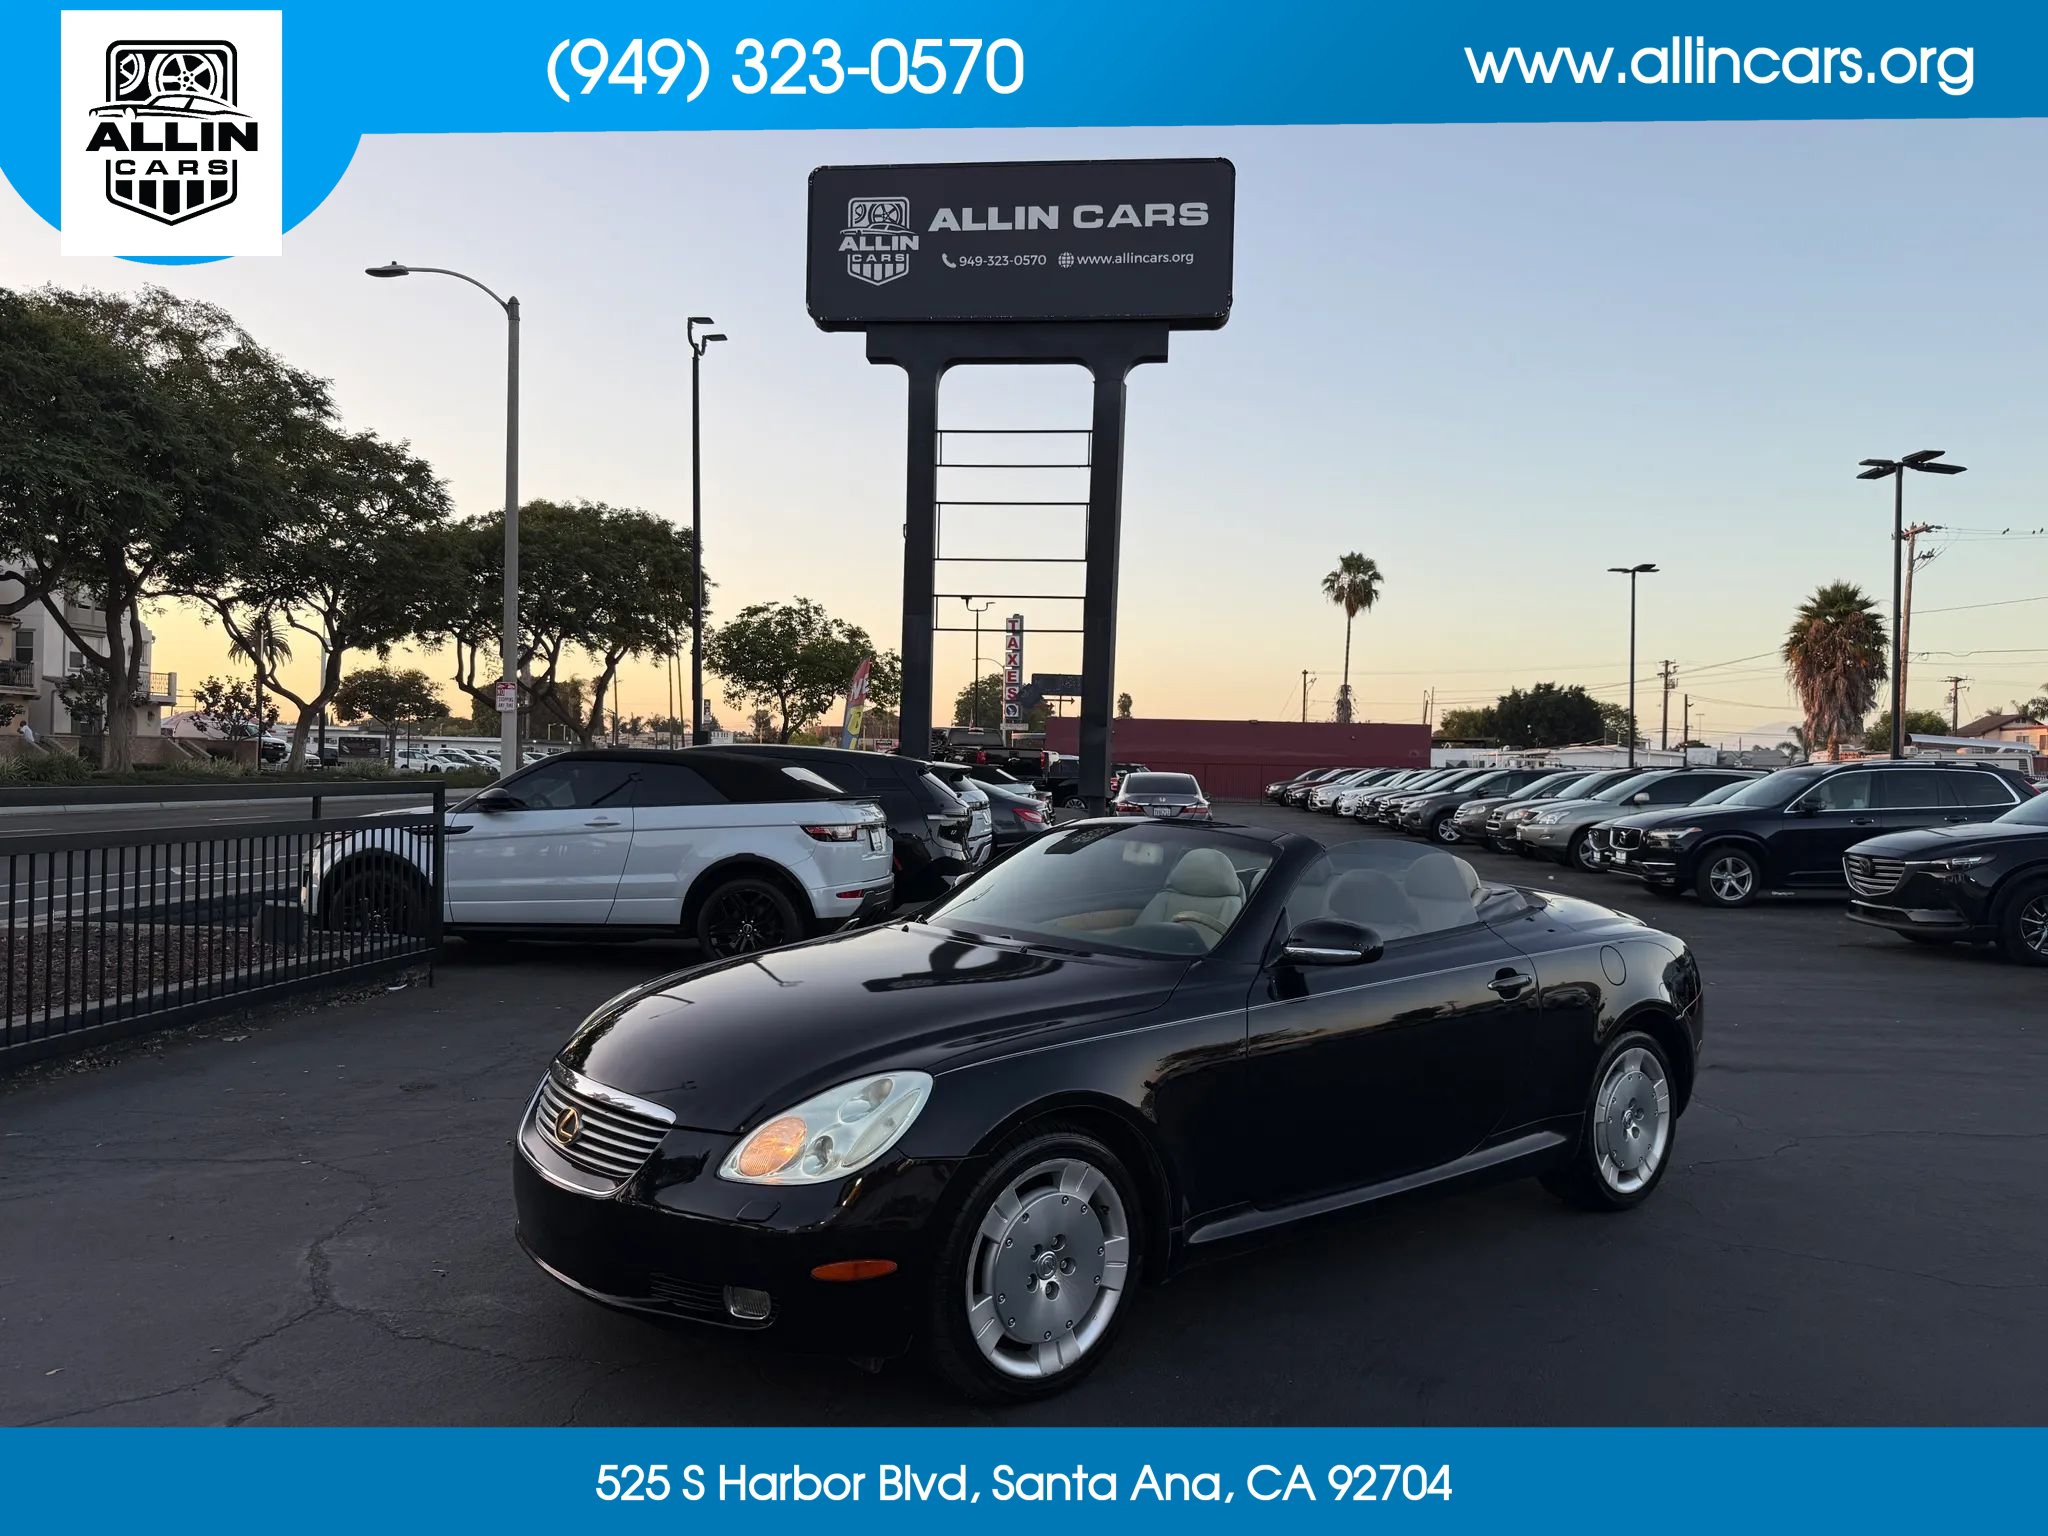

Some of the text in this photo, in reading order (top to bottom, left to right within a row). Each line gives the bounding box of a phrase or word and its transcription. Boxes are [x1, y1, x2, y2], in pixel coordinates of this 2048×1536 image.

[928, 202, 1209, 232] ALLIN CARS
[839, 235, 919, 252] ALLIN
[851, 254, 905, 262] CARS
[958, 252, 1194, 268] 949-323-0570 www.allincars.org
[1007, 620, 1019, 700] TAXES
